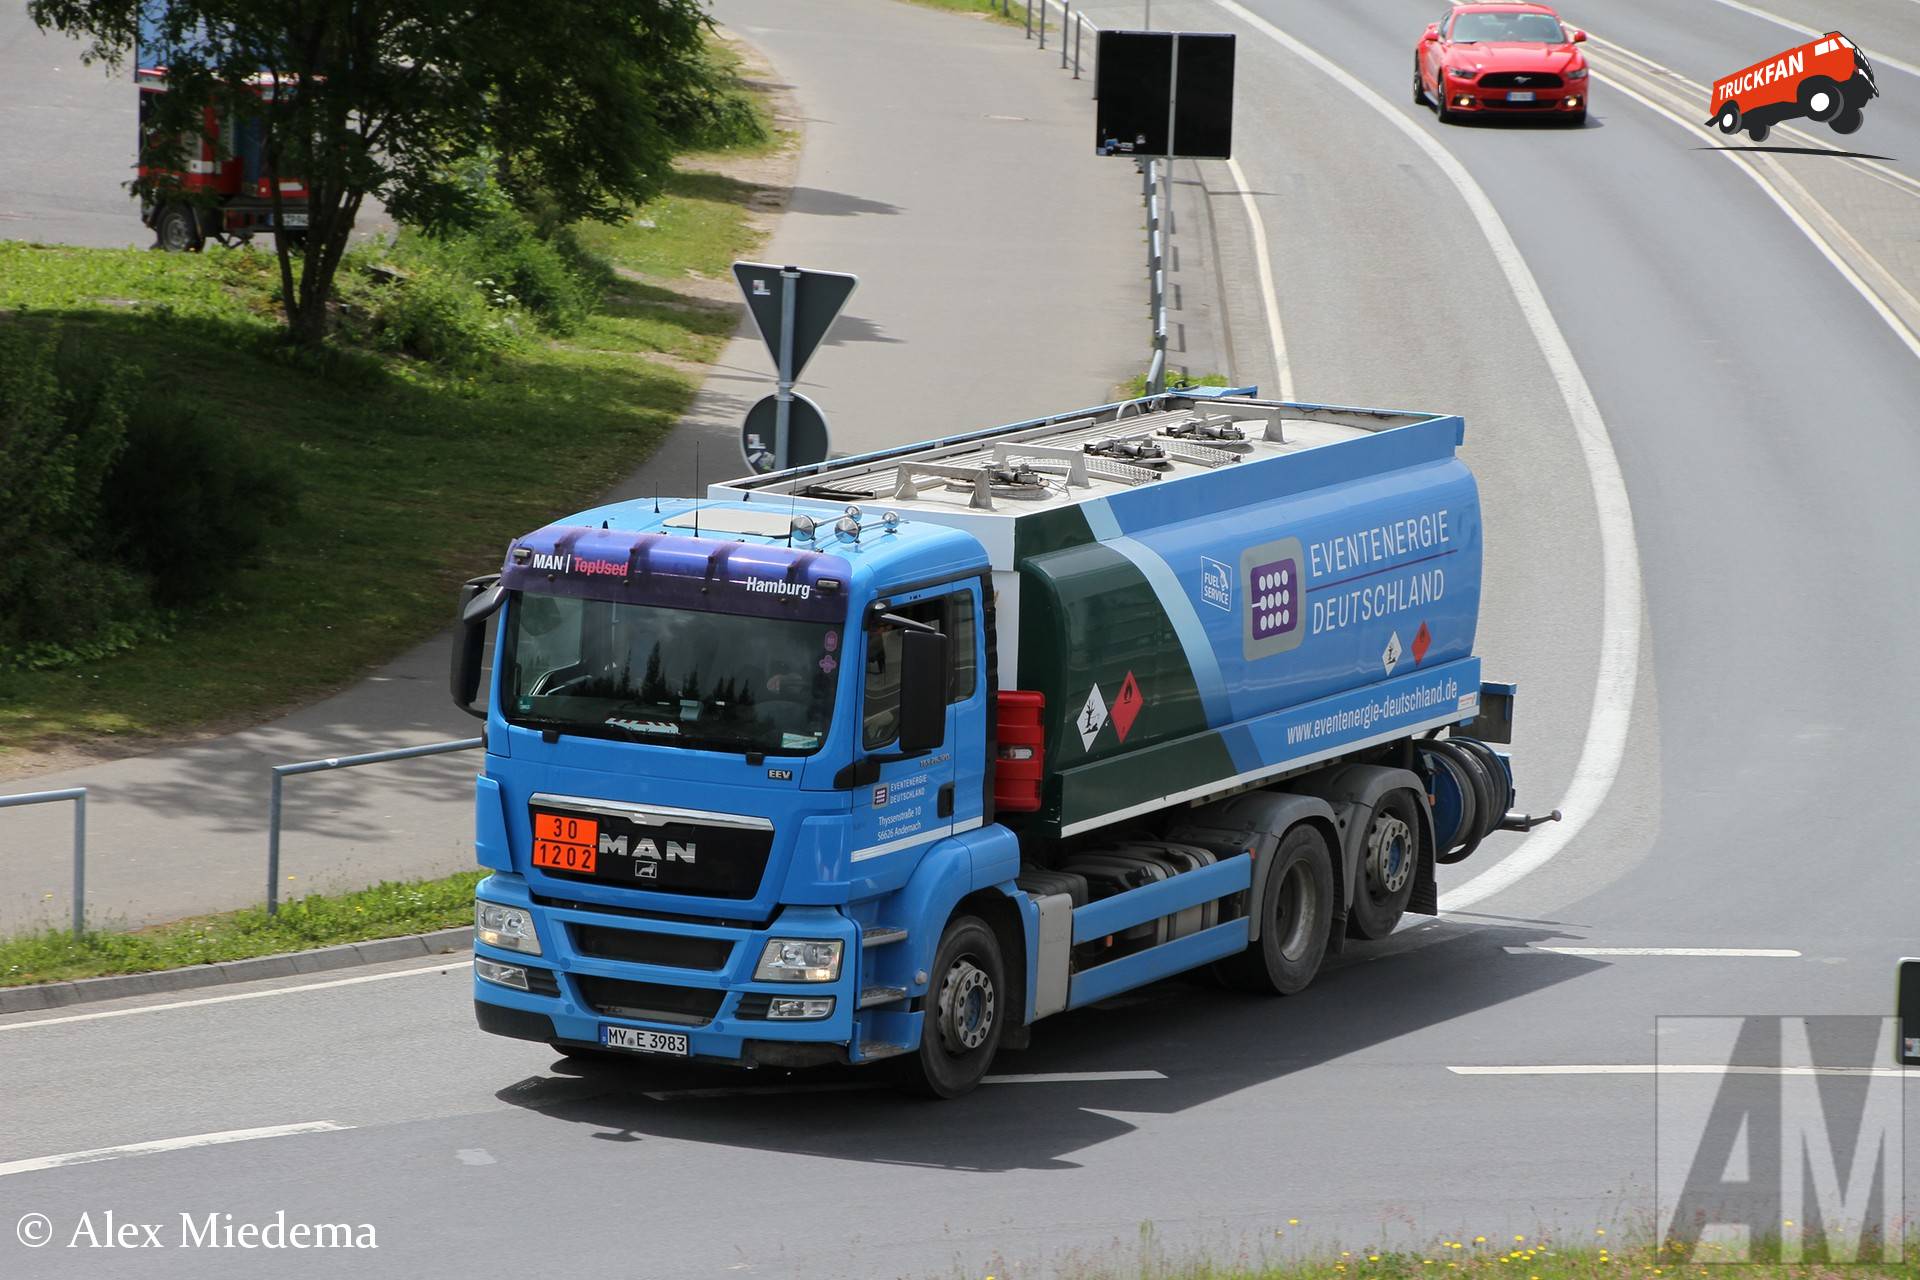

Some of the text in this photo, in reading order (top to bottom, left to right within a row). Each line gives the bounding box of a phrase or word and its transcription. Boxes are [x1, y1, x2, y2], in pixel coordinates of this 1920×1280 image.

[1310, 509, 1450, 577] EVENTENERGIE
[532, 553, 629, 577] MAN TopUsed
[746, 576, 811, 600] Hamburg
[1204, 572, 1220, 589] FUEL
[1204, 585, 1229, 605] SERVICE
[1312, 568, 1445, 635] DEUTSCHLAND
[1287, 677, 1458, 745] www.eventenergie-deutschland.de
[768, 769, 791, 779] EEV
[553, 818, 577, 839] 30
[539, 844, 592, 869] 1202
[599, 833, 696, 864] MAN
[608, 1028, 685, 1052] MY E 3983
